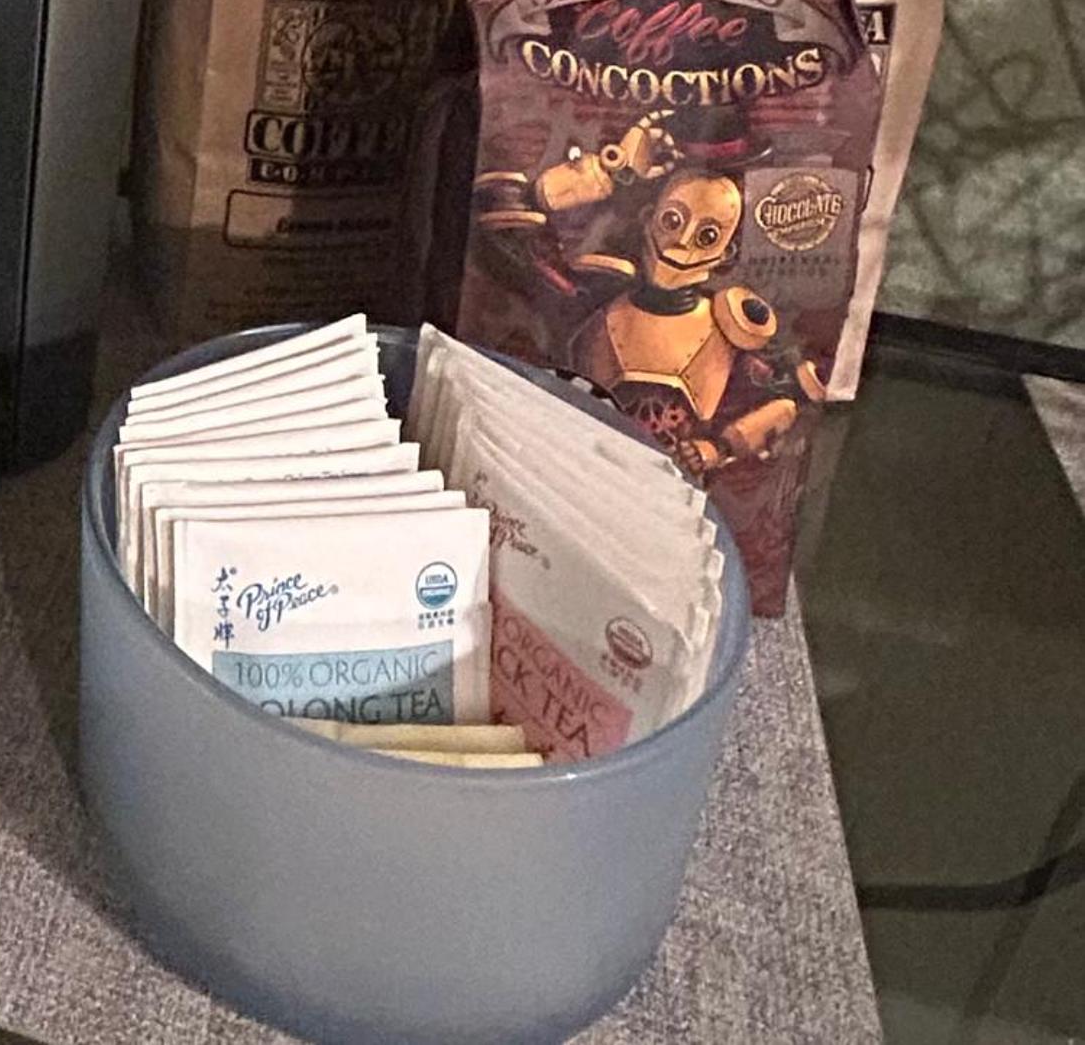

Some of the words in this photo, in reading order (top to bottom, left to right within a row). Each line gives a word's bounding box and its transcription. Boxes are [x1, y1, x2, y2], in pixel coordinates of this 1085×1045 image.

[576, 0, 748, 66] Coffee
[521, 39, 823, 107] CONCOCTIONS
[236, 573, 308, 619] Prince
[235, 660, 304, 689] 100%
[309, 650, 439, 688] ORGANIC
[500, 616, 608, 727] ORGANIC
[260, 694, 381, 725] OLONG
[389, 688, 445, 722] TEA
[542, 689, 590, 758] TEA
